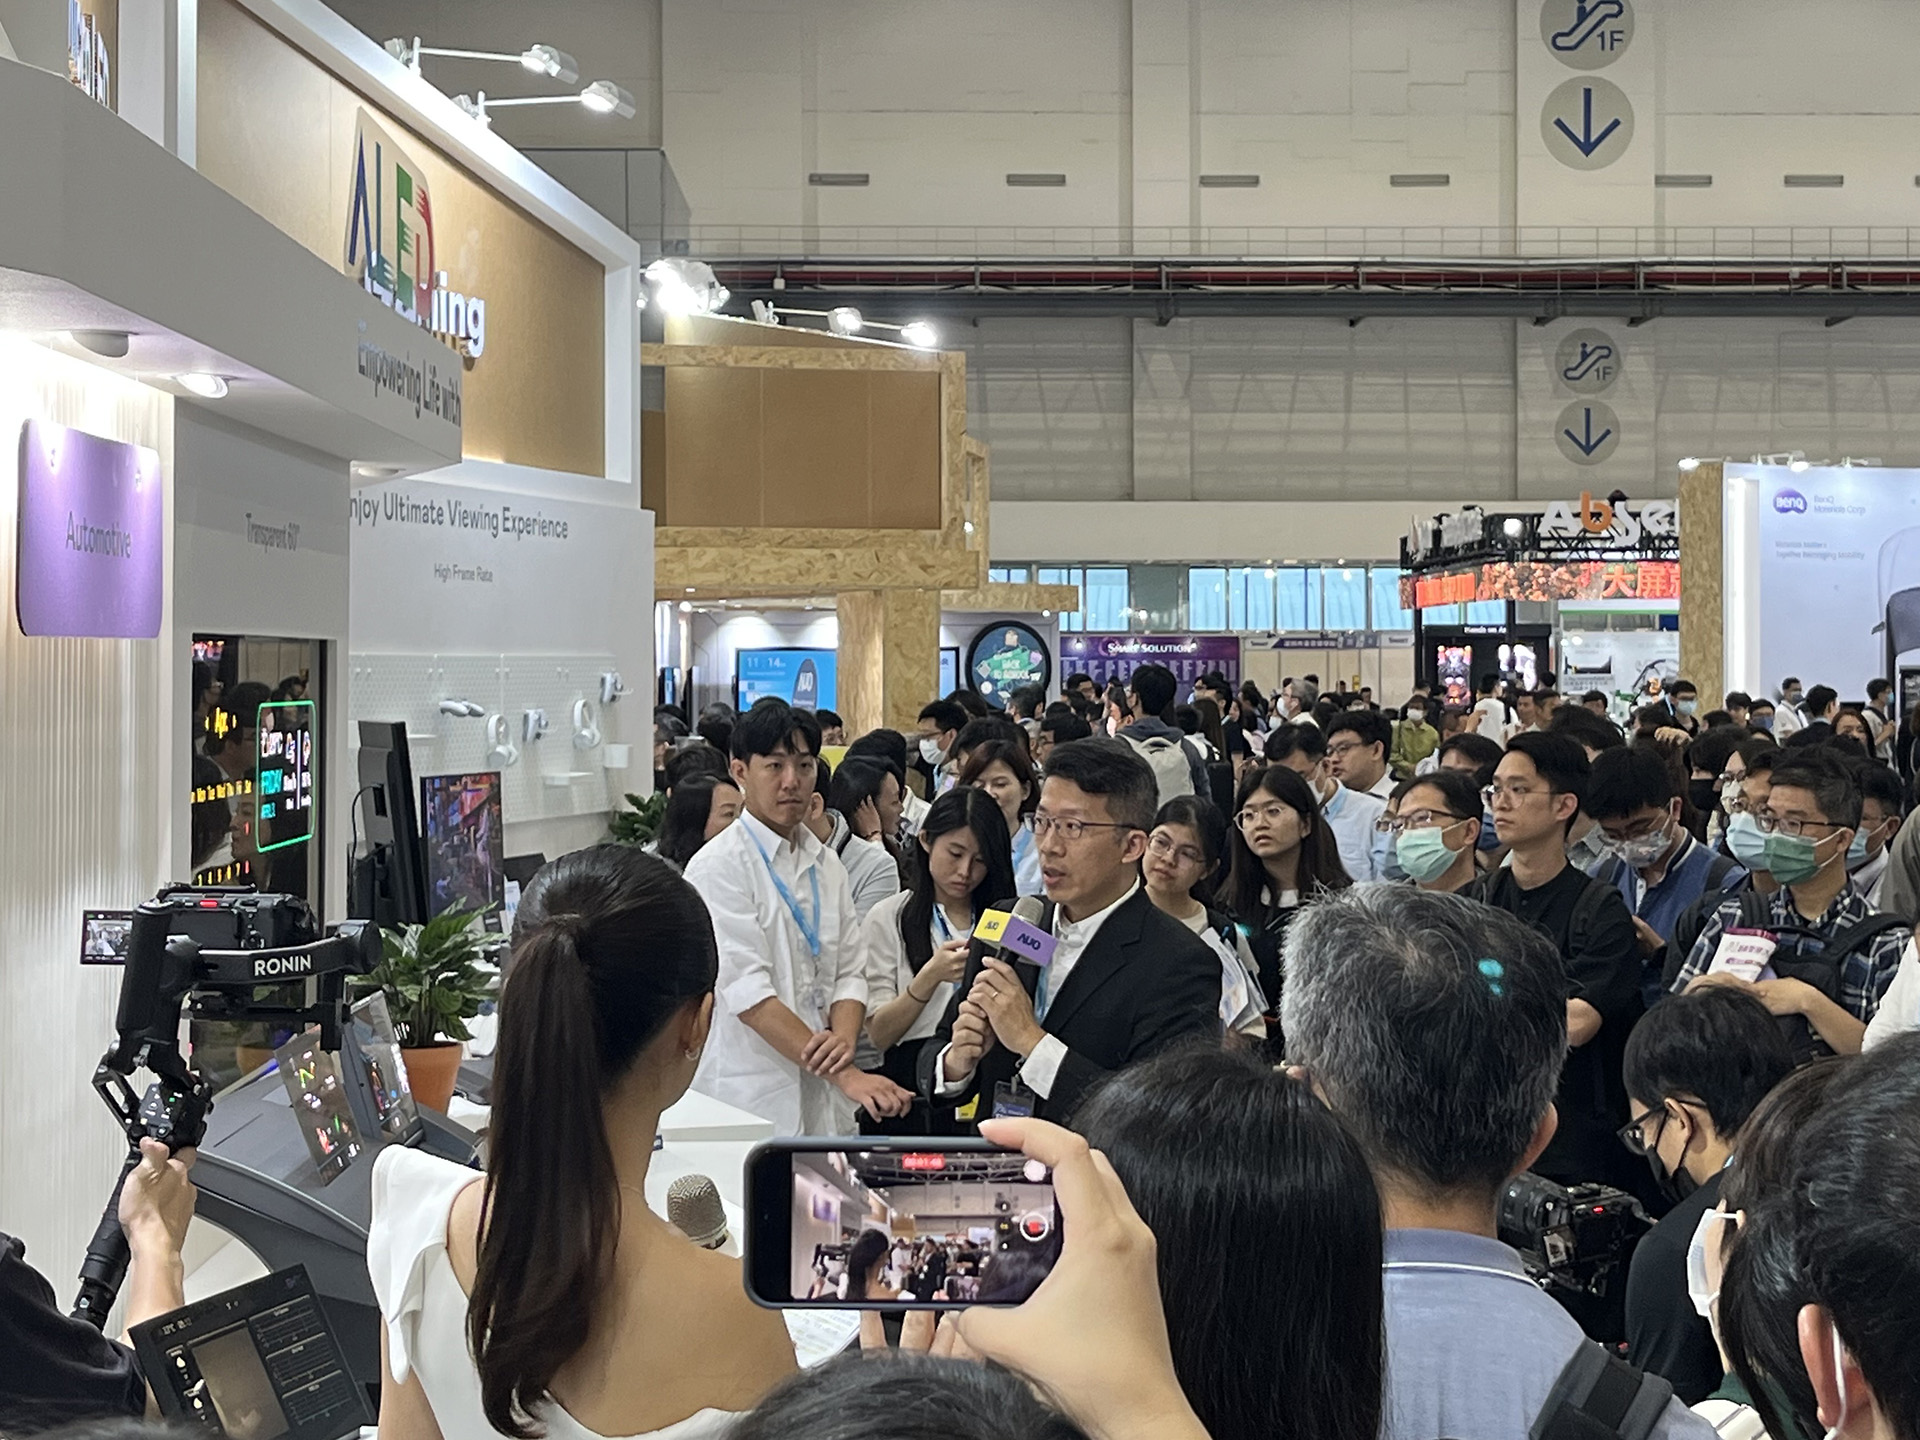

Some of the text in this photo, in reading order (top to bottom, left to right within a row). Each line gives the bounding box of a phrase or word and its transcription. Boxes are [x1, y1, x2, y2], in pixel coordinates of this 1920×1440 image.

[1597, 30, 1624, 51] 1F
[1594, 366, 1613, 381] 1F
[358, 343, 462, 427] Empowering Life with
[1776, 496, 1804, 511] BenQ
[350, 490, 568, 540] njoy Ultimate Viewing Experience
[65, 510, 131, 559] Automotive
[245, 512, 286, 553] Transparent
[434, 563, 493, 583] High Frame Rate
[1017, 933, 1041, 951] AUO
[254, 954, 312, 977] RONIN
